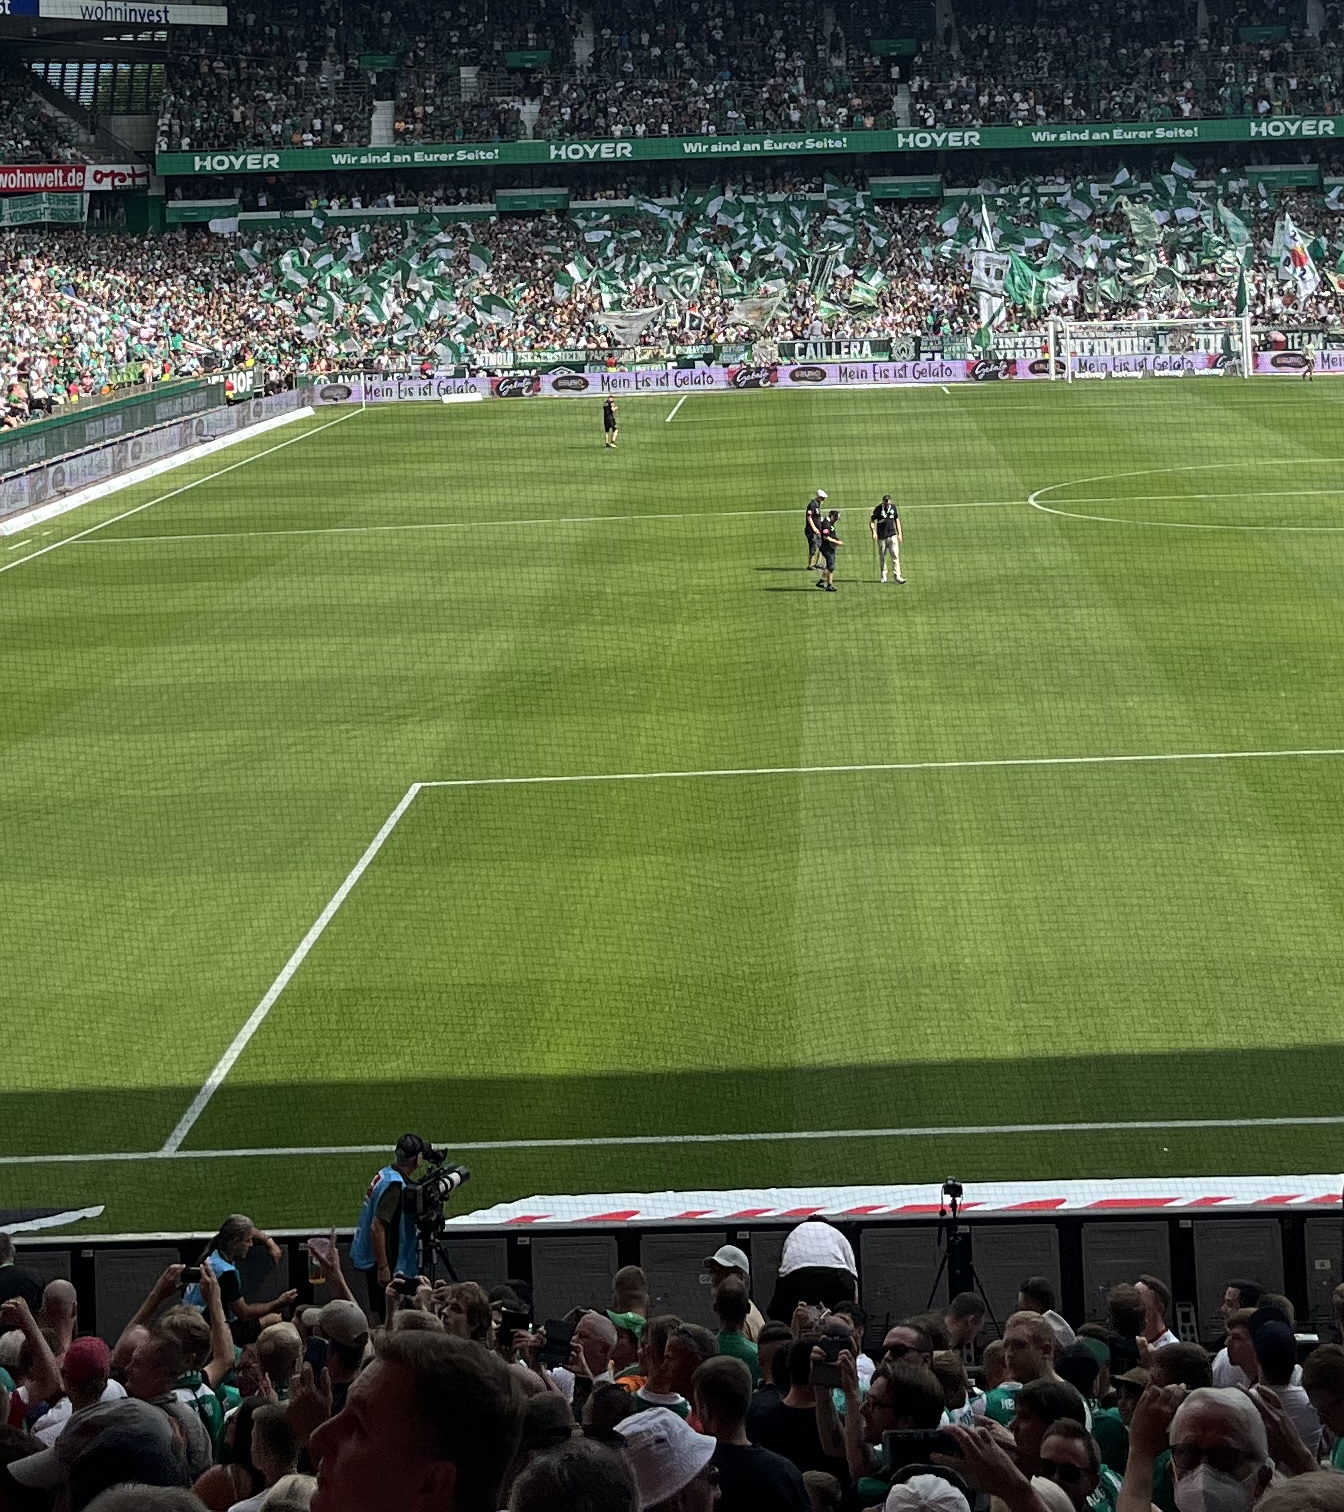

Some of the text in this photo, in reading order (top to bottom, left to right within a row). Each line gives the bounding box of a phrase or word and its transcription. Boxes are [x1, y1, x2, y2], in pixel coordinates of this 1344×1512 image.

[80, 1, 170, 23] wohninvest
[1032, 127, 1199, 143] Wir sind an Eurer Seite!
[1250, 120, 1335, 137] HOYER
[683, 137, 848, 153] Wir sind an Eurer Seite!
[898, 132, 980, 147] HOYER
[331, 149, 499, 165] Wir sind an Eurer Seite!
[550, 142, 632, 160] HOYER
[194, 153, 280, 171] HOYER
[794, 341, 872, 361] CAILLERA
[601, 371, 668, 391] Mein Eis ist
[839, 363, 907, 382] Mein Eis ist
[364, 380, 433, 400] Mein Eis ist
